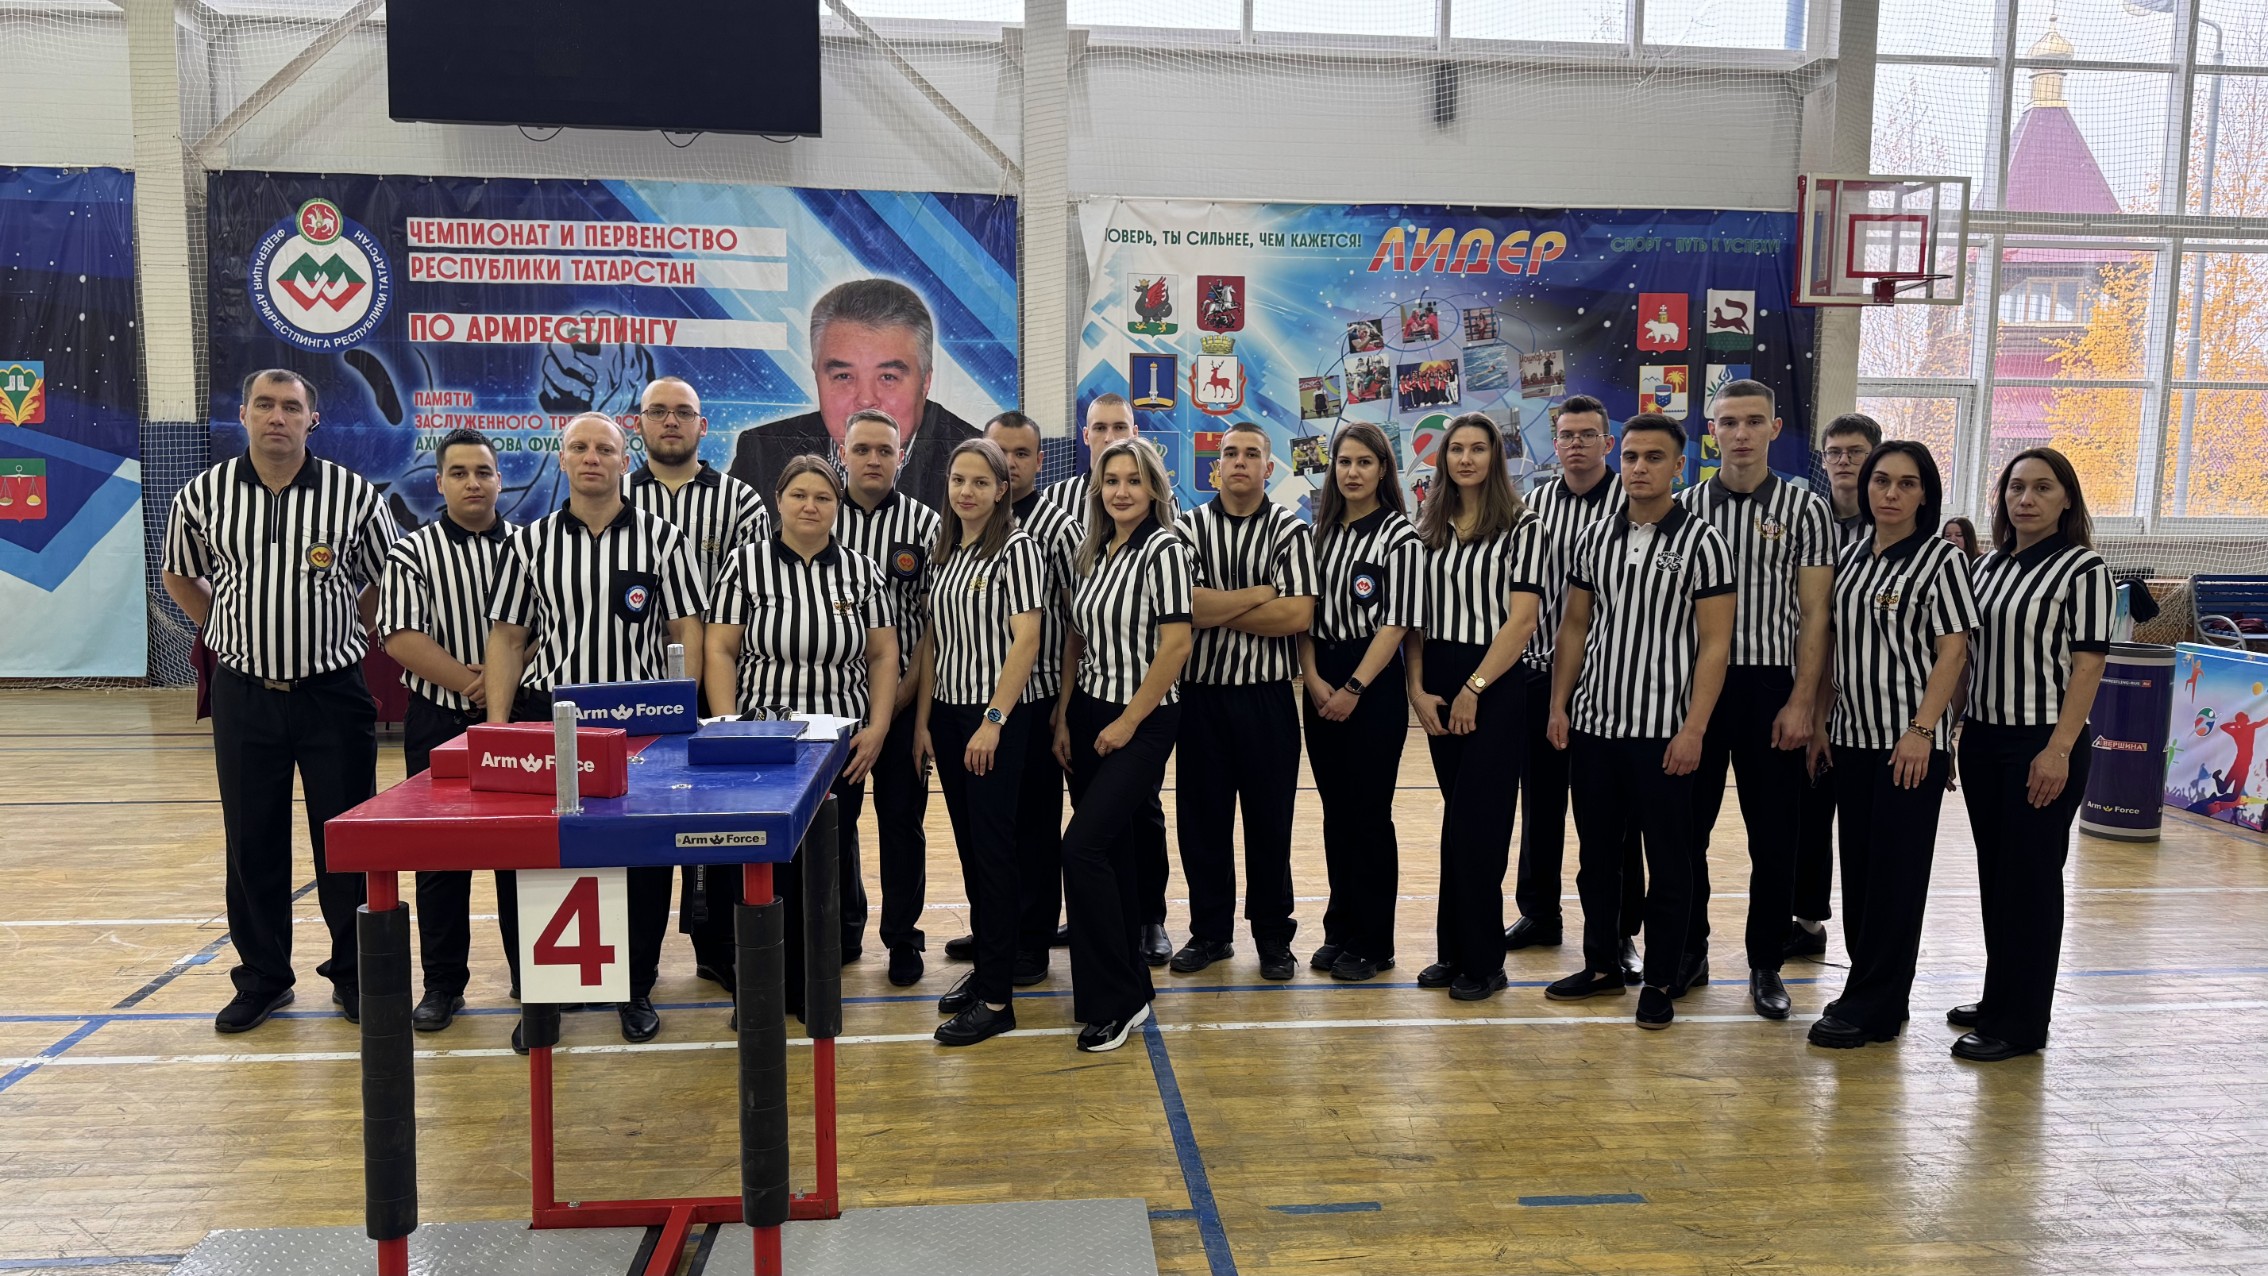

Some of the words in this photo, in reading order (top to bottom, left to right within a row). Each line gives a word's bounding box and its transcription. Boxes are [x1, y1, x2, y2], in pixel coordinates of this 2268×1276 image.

[409, 221, 550, 246] ЧЕМПИОНАТ
[560, 224, 574, 246] И
[585, 225, 738, 251] ПЕРВЕНСТВО
[1162, 231, 1181, 244] ТЫ
[1187, 231, 1254, 248] СИЛЬНЕЕ,
[1259, 232, 1285, 247] ЧЕМ
[1291, 233, 1362, 248] КАЖЕТСЯ!
[1610, 237, 1662, 252] СПОРТ
[1675, 237, 1708, 252] ПУТЬ
[1712, 238, 1721, 252] К
[1724, 238, 1781, 253] УСПЕХУ!
[252, 228, 286, 291] ФЕДЕРАЦИЯ
[354, 230, 389, 291] ТАТАРСТАН
[1367, 226, 1567, 275] ЛИДЕР
[411, 256, 561, 281] РЕСПУБЛИКИ
[571, 259, 695, 284] ТАТАРСТАН
[255, 293, 331, 348] АРМРЕСТЛИНГА
[333, 293, 388, 347] РЕСПУБЛИКИ
[410, 314, 455, 341] ПО
[466, 316, 677, 345] АРМРЕСТЛИНГУ
[414, 391, 473, 407] ПАМЯТИ
[415, 414, 543, 430] ЗАСЛУЖЕННОГО
[576, 707, 608, 720] Arm
[636, 703, 684, 717] Force
[481, 751, 518, 769] Arm
[545, 755, 595, 773] Fce
[2087, 801, 2101, 809] Arm
[2114, 806, 2140, 814] Force
[682, 835, 708, 844] Arm
[726, 834, 759, 843] Force
[533, 876, 615, 986] 4
